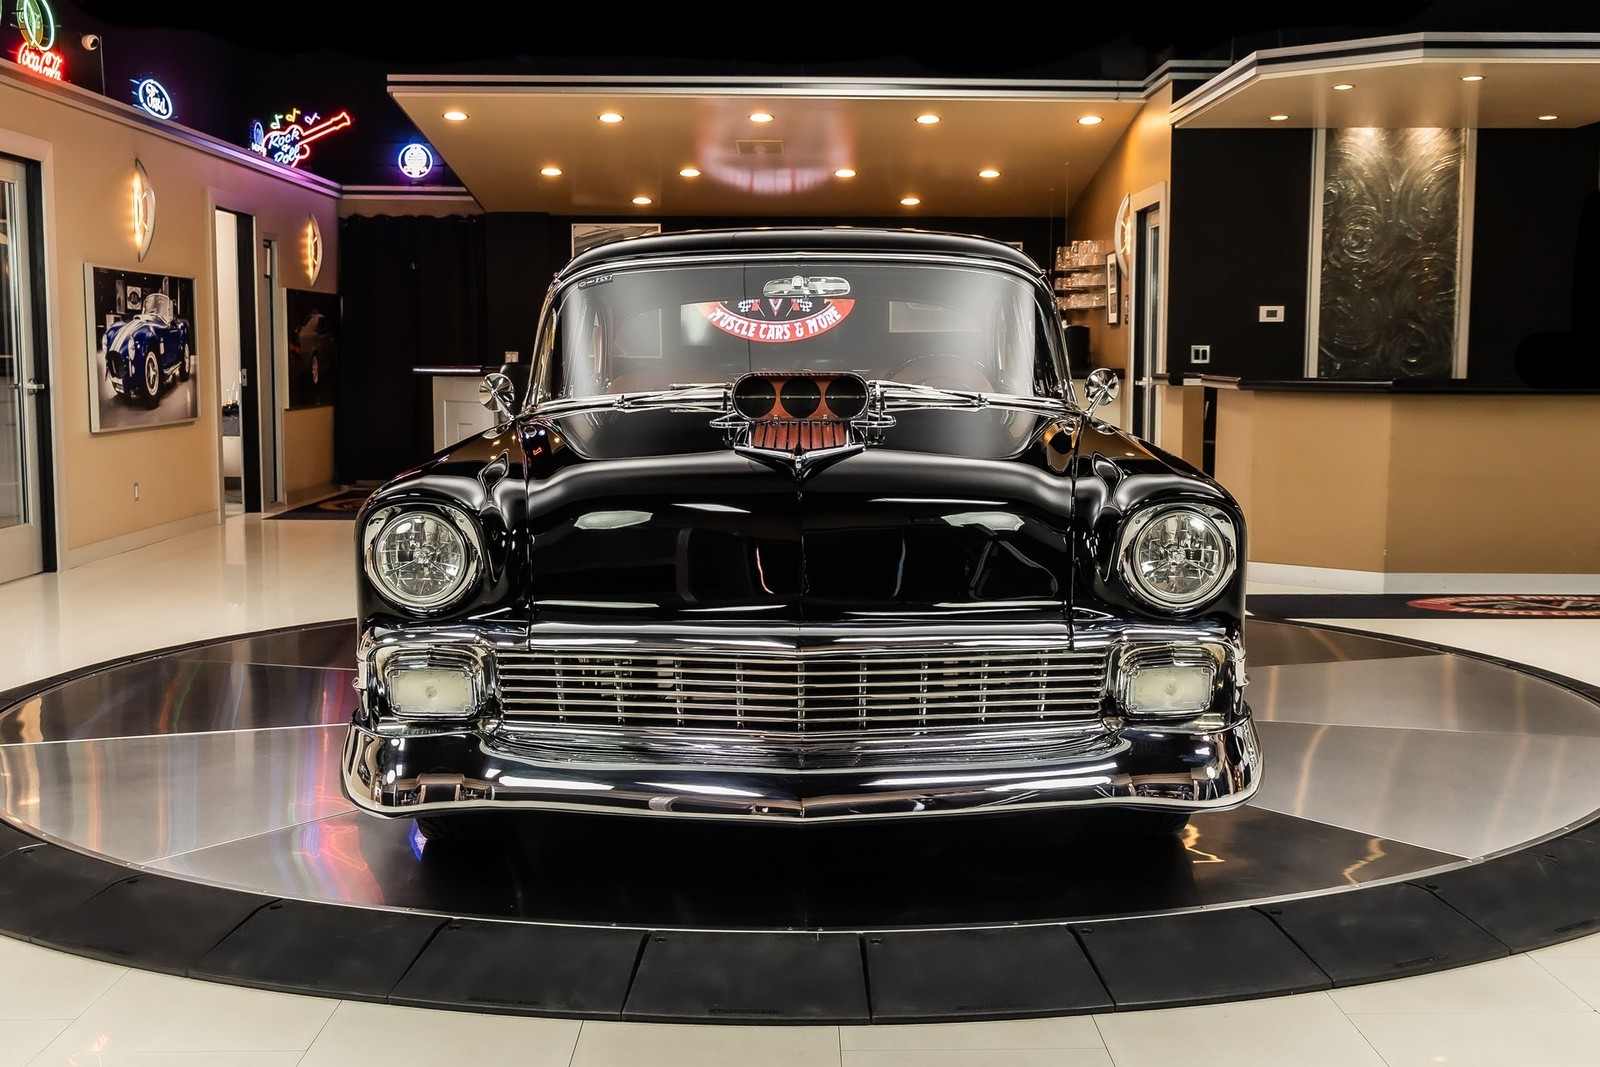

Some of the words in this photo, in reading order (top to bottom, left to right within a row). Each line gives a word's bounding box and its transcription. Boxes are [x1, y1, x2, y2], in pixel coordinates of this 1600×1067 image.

[145, 83, 168, 115] Ford
[268, 127, 300, 150] Rock
[708, 307, 757, 338] MUSCLE
[759, 323, 791, 340] CARS
[804, 305, 842, 335] MORE
